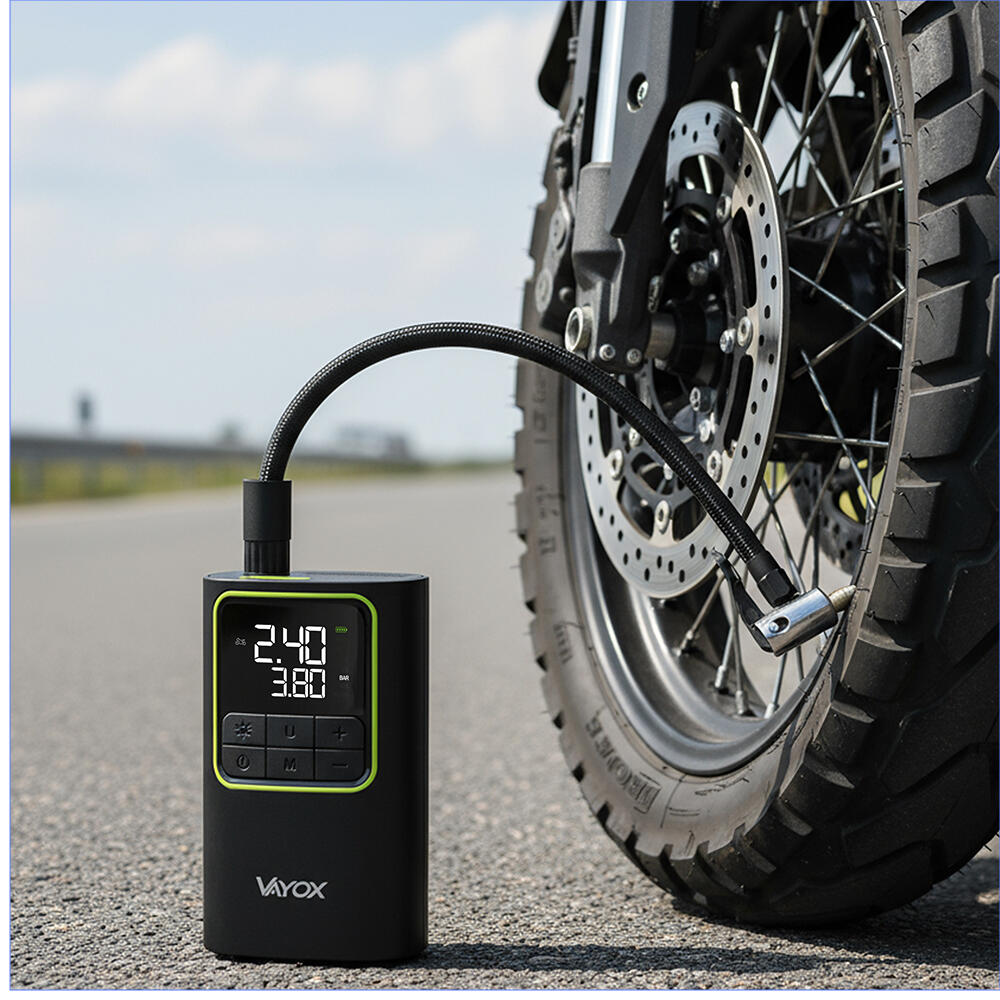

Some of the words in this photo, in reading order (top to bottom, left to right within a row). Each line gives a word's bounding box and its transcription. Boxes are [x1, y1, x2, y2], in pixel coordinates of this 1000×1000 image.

[253, 623, 327, 666] 2.40
[271, 666, 326, 699] 3.80
[338, 674, 350, 682] BAR
[255, 875, 329, 900] VAYOX
